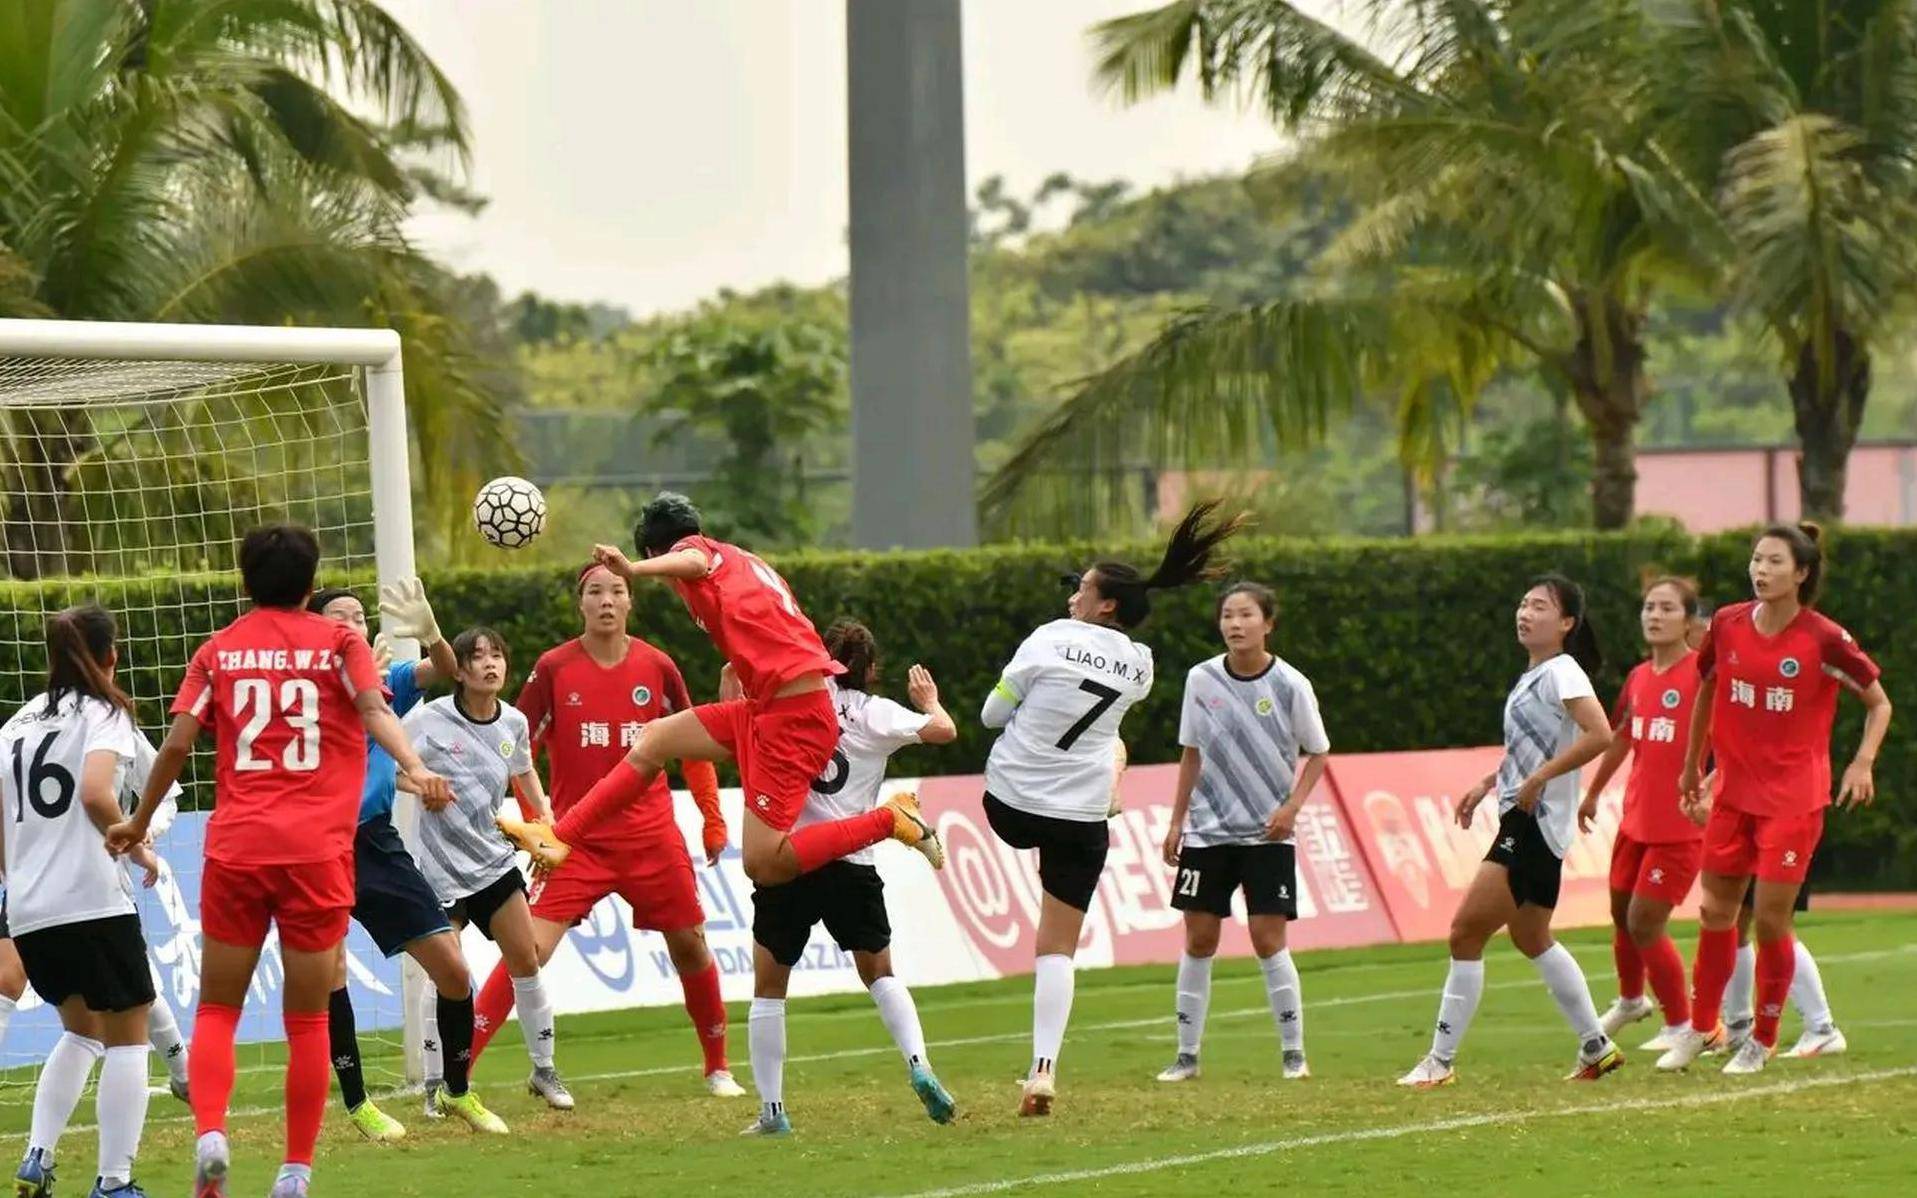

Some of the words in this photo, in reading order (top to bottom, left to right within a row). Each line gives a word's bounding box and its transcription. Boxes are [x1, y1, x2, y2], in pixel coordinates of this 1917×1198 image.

[1065, 648, 1145, 683] LIAO.M.X
[1054, 678, 1122, 751] 7
[1730, 678, 1795, 713] 海南
[233, 678, 321, 772] 23
[11, 728, 76, 823] 16
[1179, 868, 1201, 898] 21
